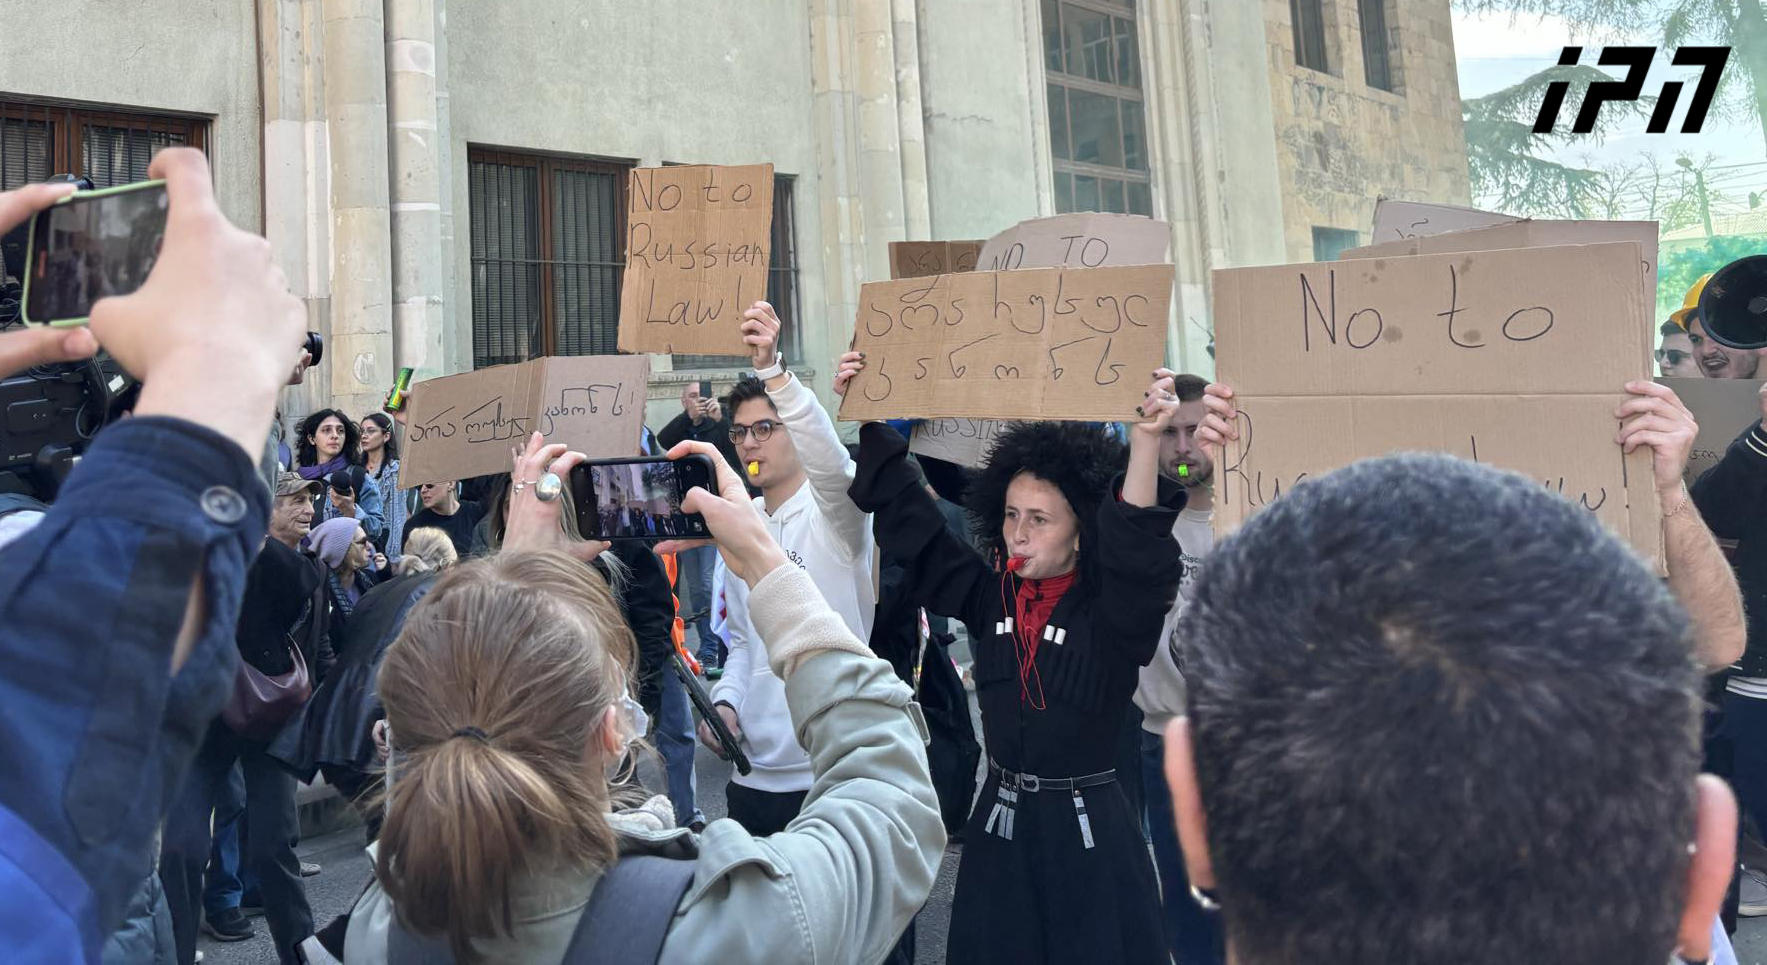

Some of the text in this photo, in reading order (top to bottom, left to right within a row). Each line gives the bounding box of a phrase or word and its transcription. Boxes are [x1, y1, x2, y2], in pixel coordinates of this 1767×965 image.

[631, 168, 753, 214] No to
[628, 221, 765, 270] Russian
[1059, 234, 1109, 268] TO
[1300, 264, 1555, 352] No to
